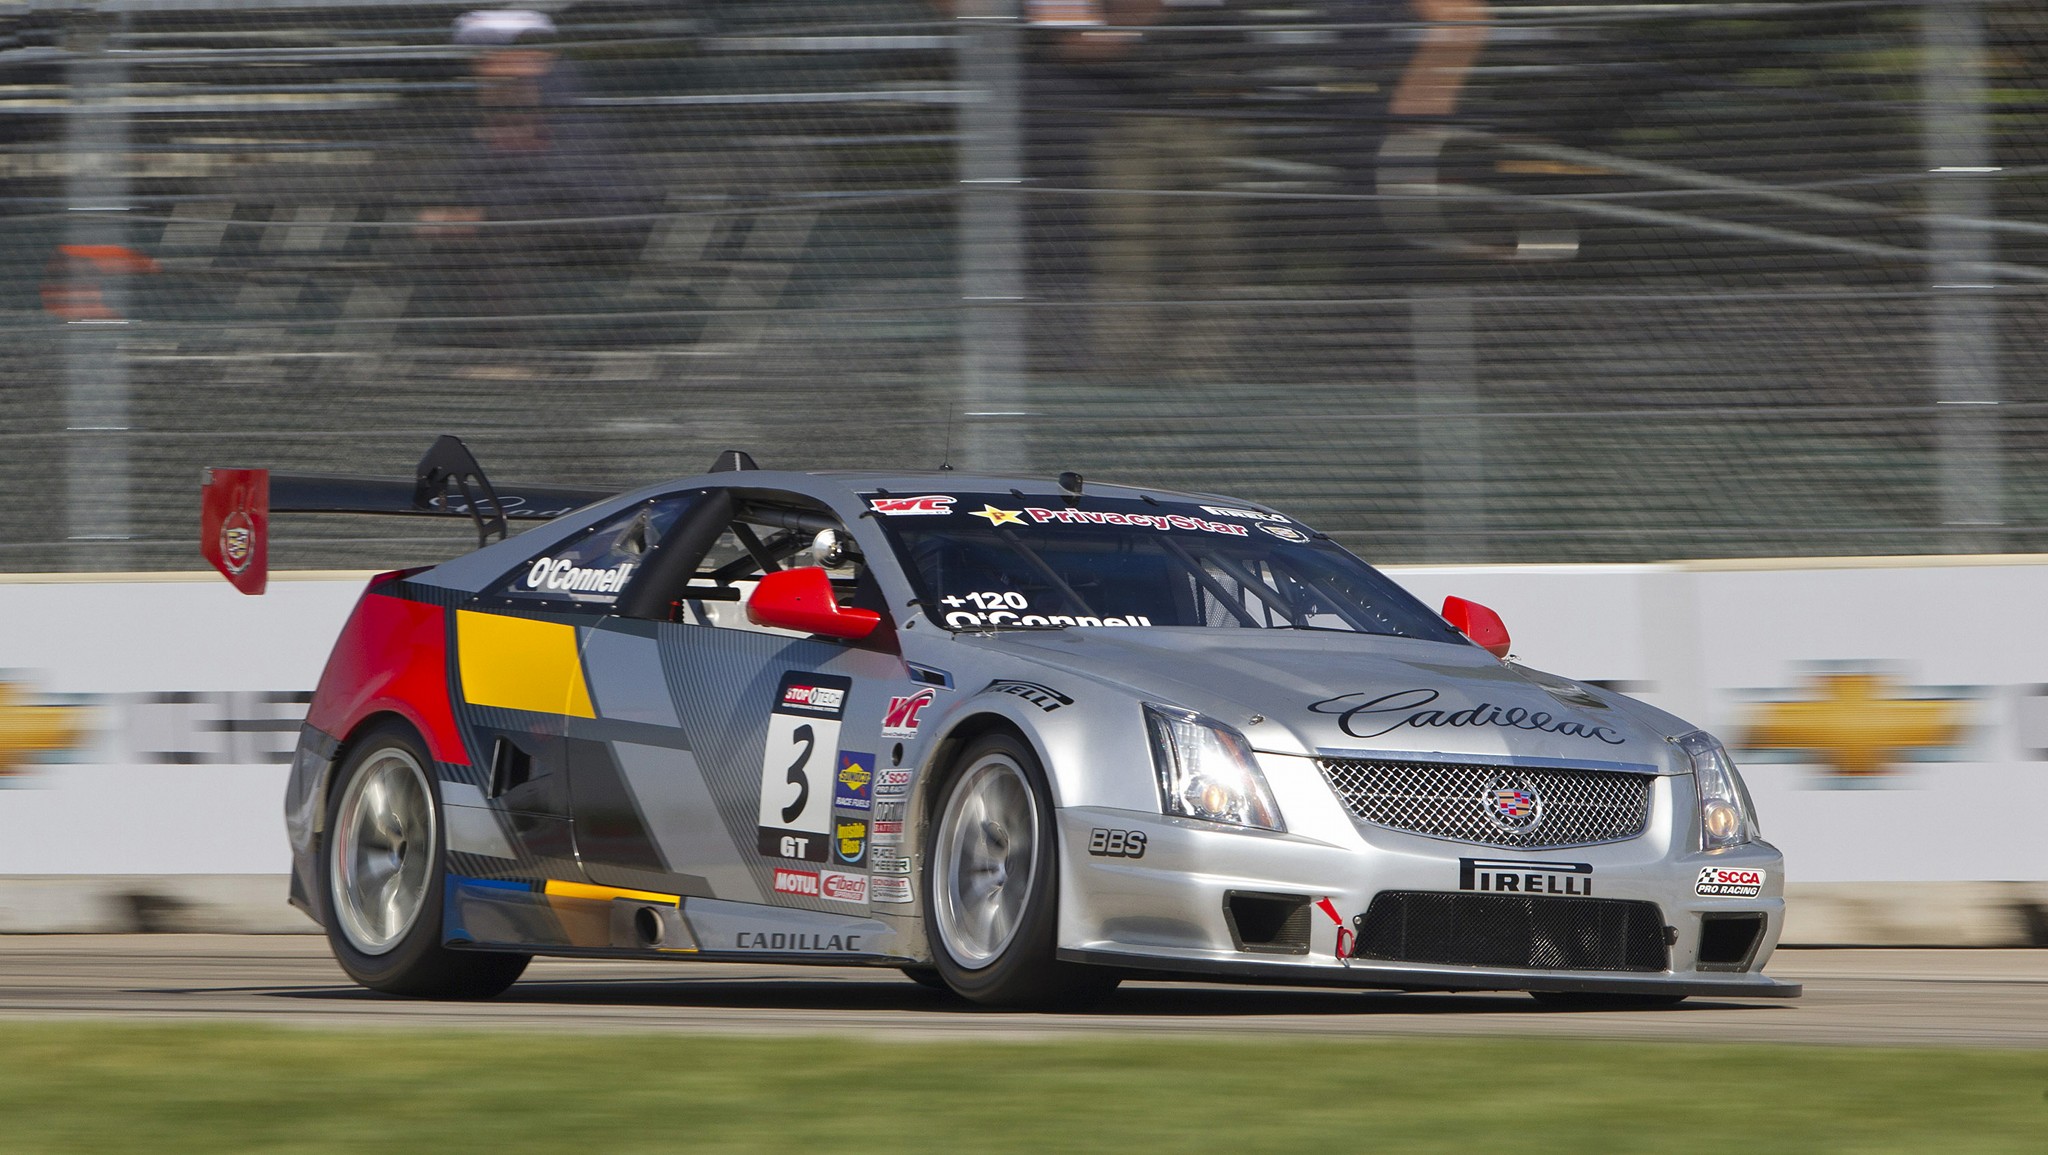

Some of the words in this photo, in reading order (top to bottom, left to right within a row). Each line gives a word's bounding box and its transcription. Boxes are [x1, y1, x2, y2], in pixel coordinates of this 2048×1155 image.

[870, 496, 954, 511] WC
[1024, 507, 1249, 537] PrivacyStar
[527, 557, 634, 593] O'Connell
[941, 592, 1028, 610] +120
[881, 692, 933, 728] WC
[1307, 688, 1626, 745] Cadillac
[782, 723, 815, 824] 3
[840, 770, 871, 784] SUNOCO
[888, 772, 911, 784] SCC
[836, 796, 853, 806] RACE
[853, 798, 870, 808] FUELS
[780, 836, 809, 859] GT
[1088, 828, 1148, 859] BBS
[775, 872, 819, 894] MOTUL
[823, 874, 867, 896] Eibach
[1460, 858, 1594, 896] PIRELLI
[1717, 871, 1761, 885] SCCA
[833, 890, 864, 901] SPRINGS
[1697, 884, 1719, 894] PRO
[1720, 886, 1758, 896] RACING
[736, 932, 862, 951] CADILLAC
